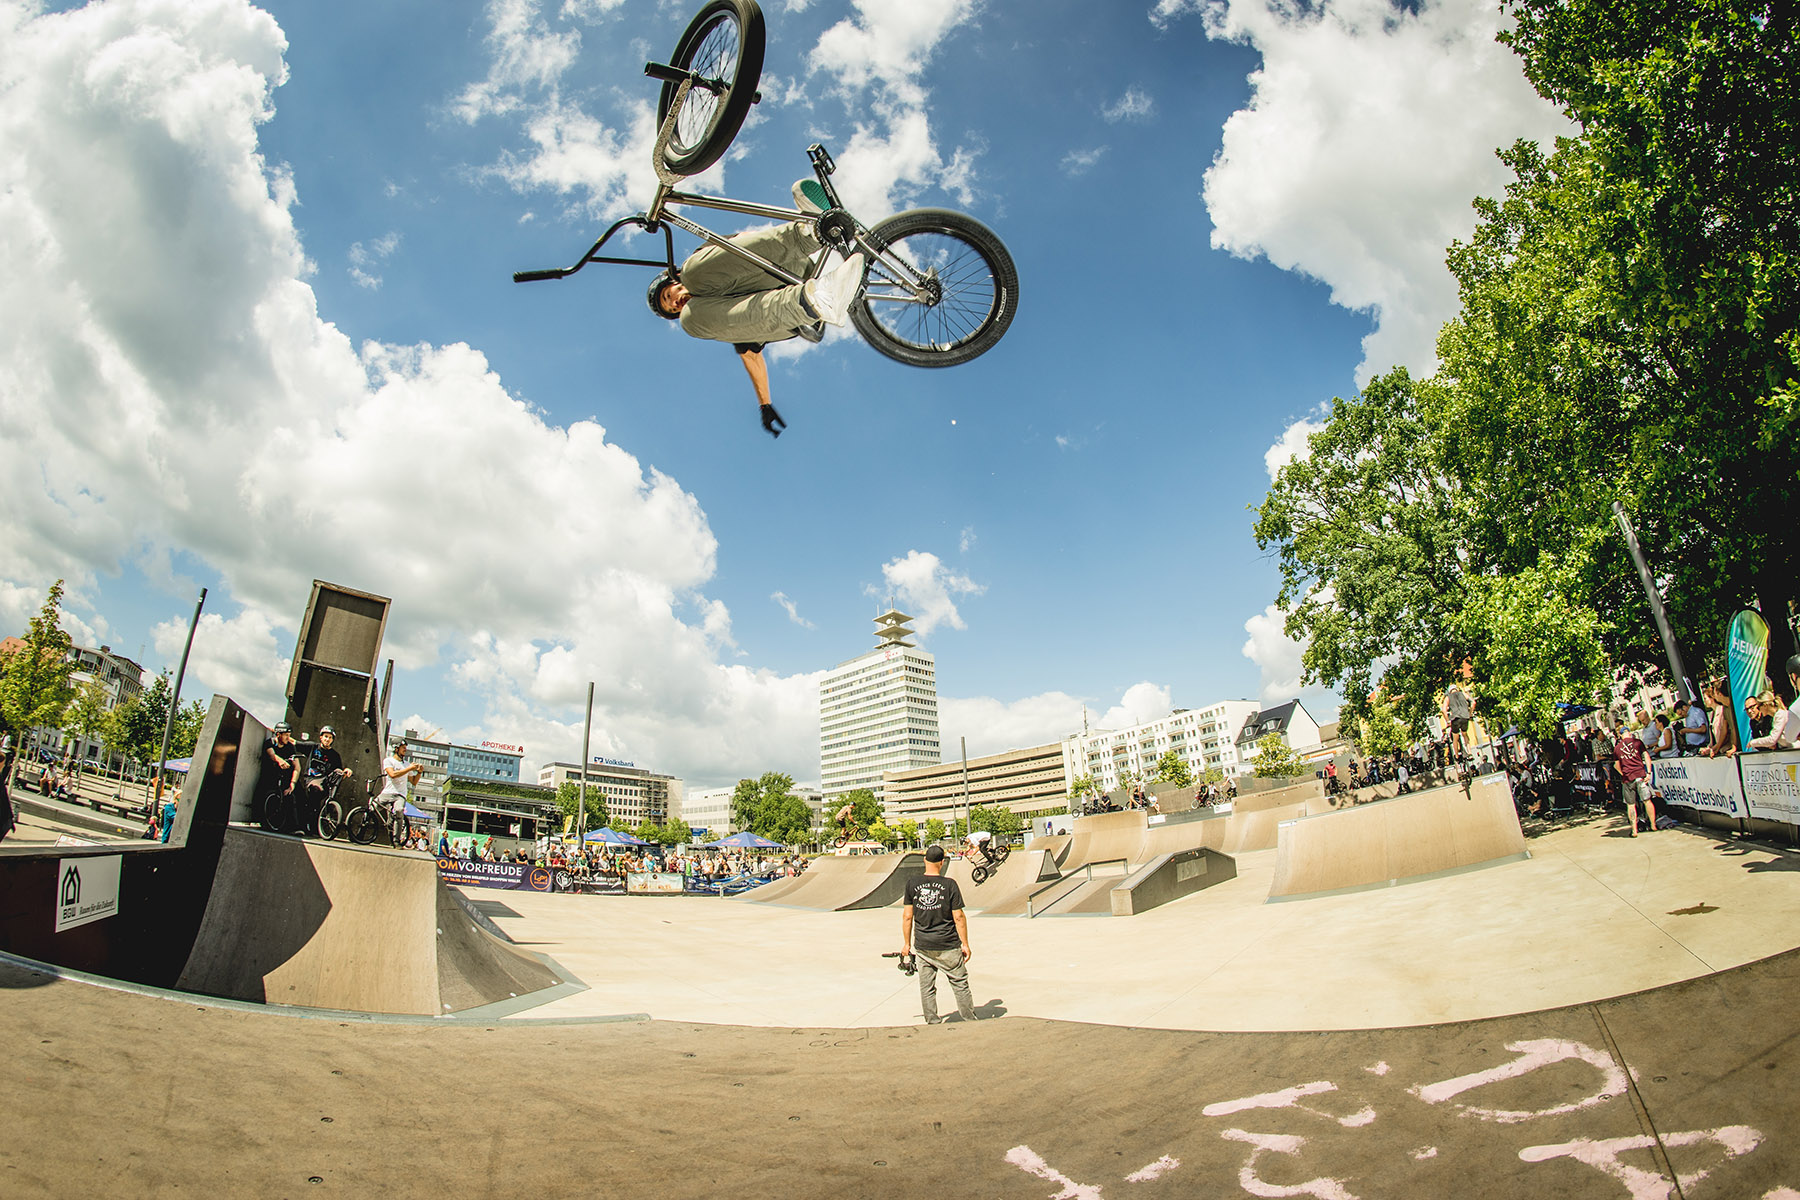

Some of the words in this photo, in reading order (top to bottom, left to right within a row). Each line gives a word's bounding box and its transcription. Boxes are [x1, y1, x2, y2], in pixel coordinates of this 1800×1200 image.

[481, 741, 516, 751] APOTHEKE
[605, 758, 635, 768] Volksbank
[1657, 761, 1689, 780] olksbank
[436, 859, 523, 877] OMVORFREUDE
[63, 907, 76, 920] BGW
